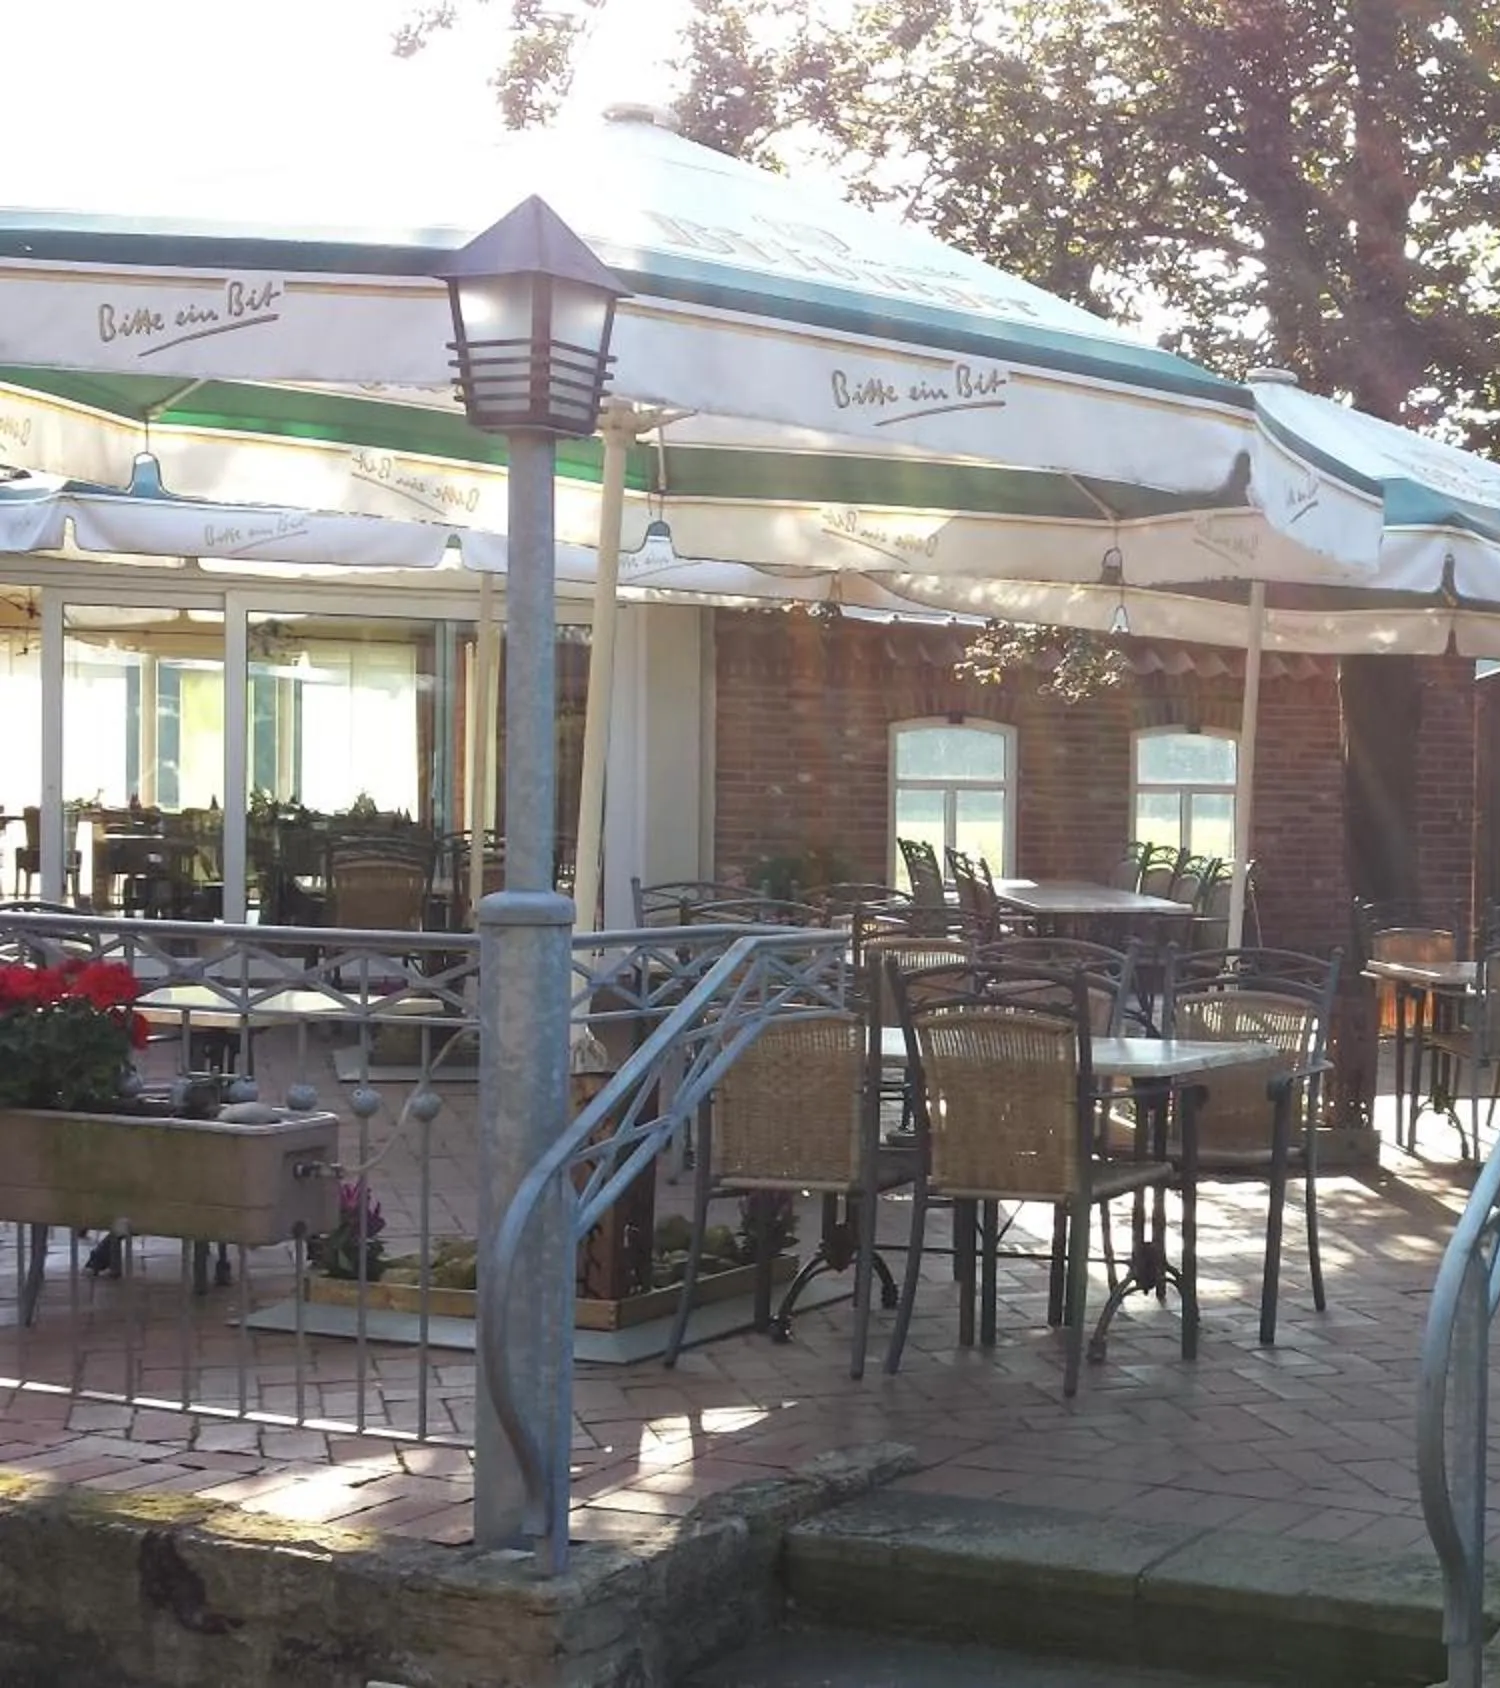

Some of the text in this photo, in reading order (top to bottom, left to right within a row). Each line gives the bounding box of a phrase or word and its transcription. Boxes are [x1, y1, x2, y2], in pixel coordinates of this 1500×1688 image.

[99, 281, 281, 342] Bitte ein Bit
[832, 364, 1007, 409] Bitte ein Bit
